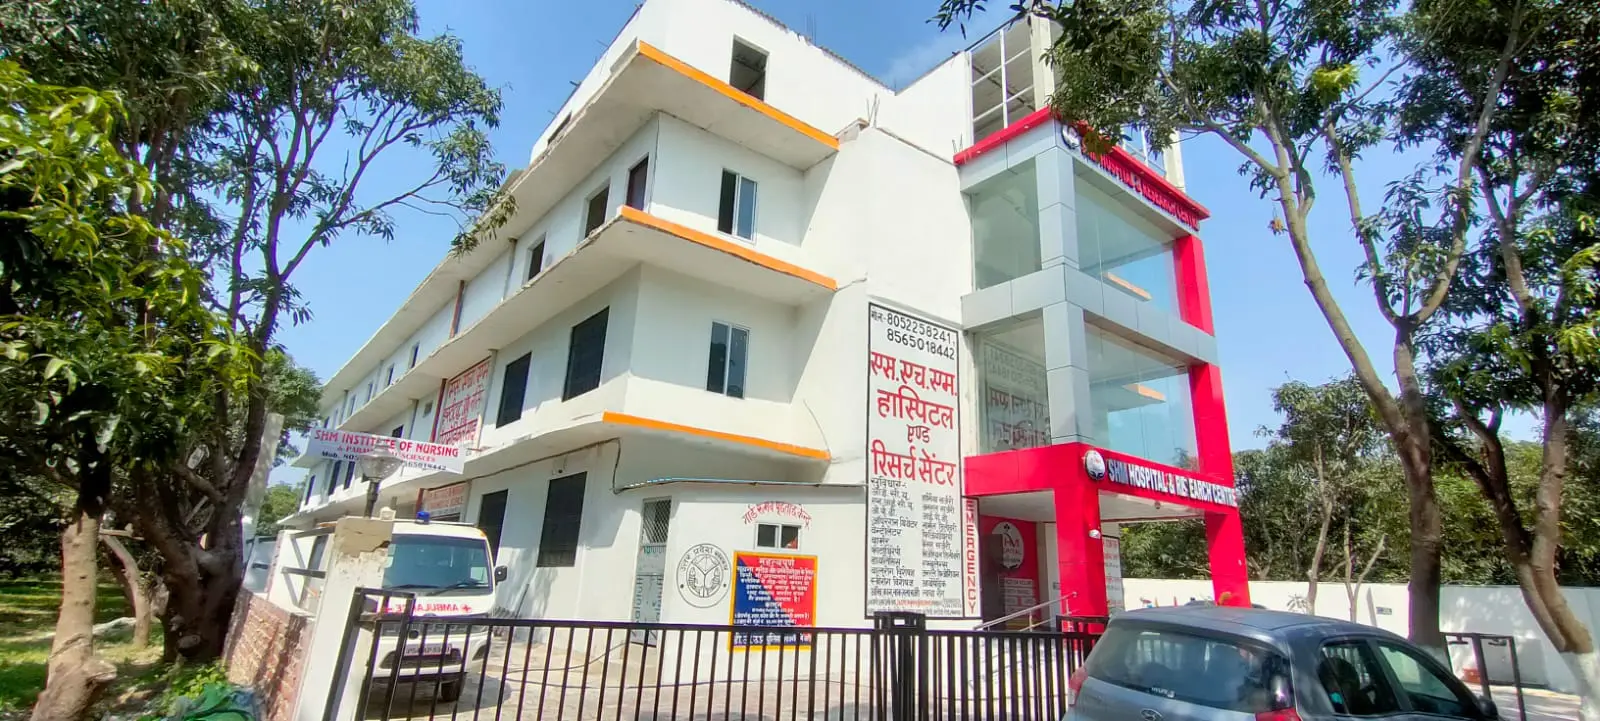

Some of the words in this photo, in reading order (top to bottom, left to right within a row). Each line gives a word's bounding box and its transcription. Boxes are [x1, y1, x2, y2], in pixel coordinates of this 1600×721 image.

[887, 328, 955, 360] 8565018442
[877, 385, 954, 429] हास्पिटल
[314, 429, 339, 442] SHM
[342, 433, 395, 450] INSTITTE
[399, 441, 413, 453] OF
[416, 443, 459, 458] NURSING
[907, 424, 930, 443] एण्ड
[871, 439, 916, 481] रिसर्च
[919, 448, 956, 487] सेंटर
[1108, 458, 1129, 484] SHM
[1128, 464, 1168, 494] HOSPITAL
[966, 499, 976, 614] EMERGENCY
